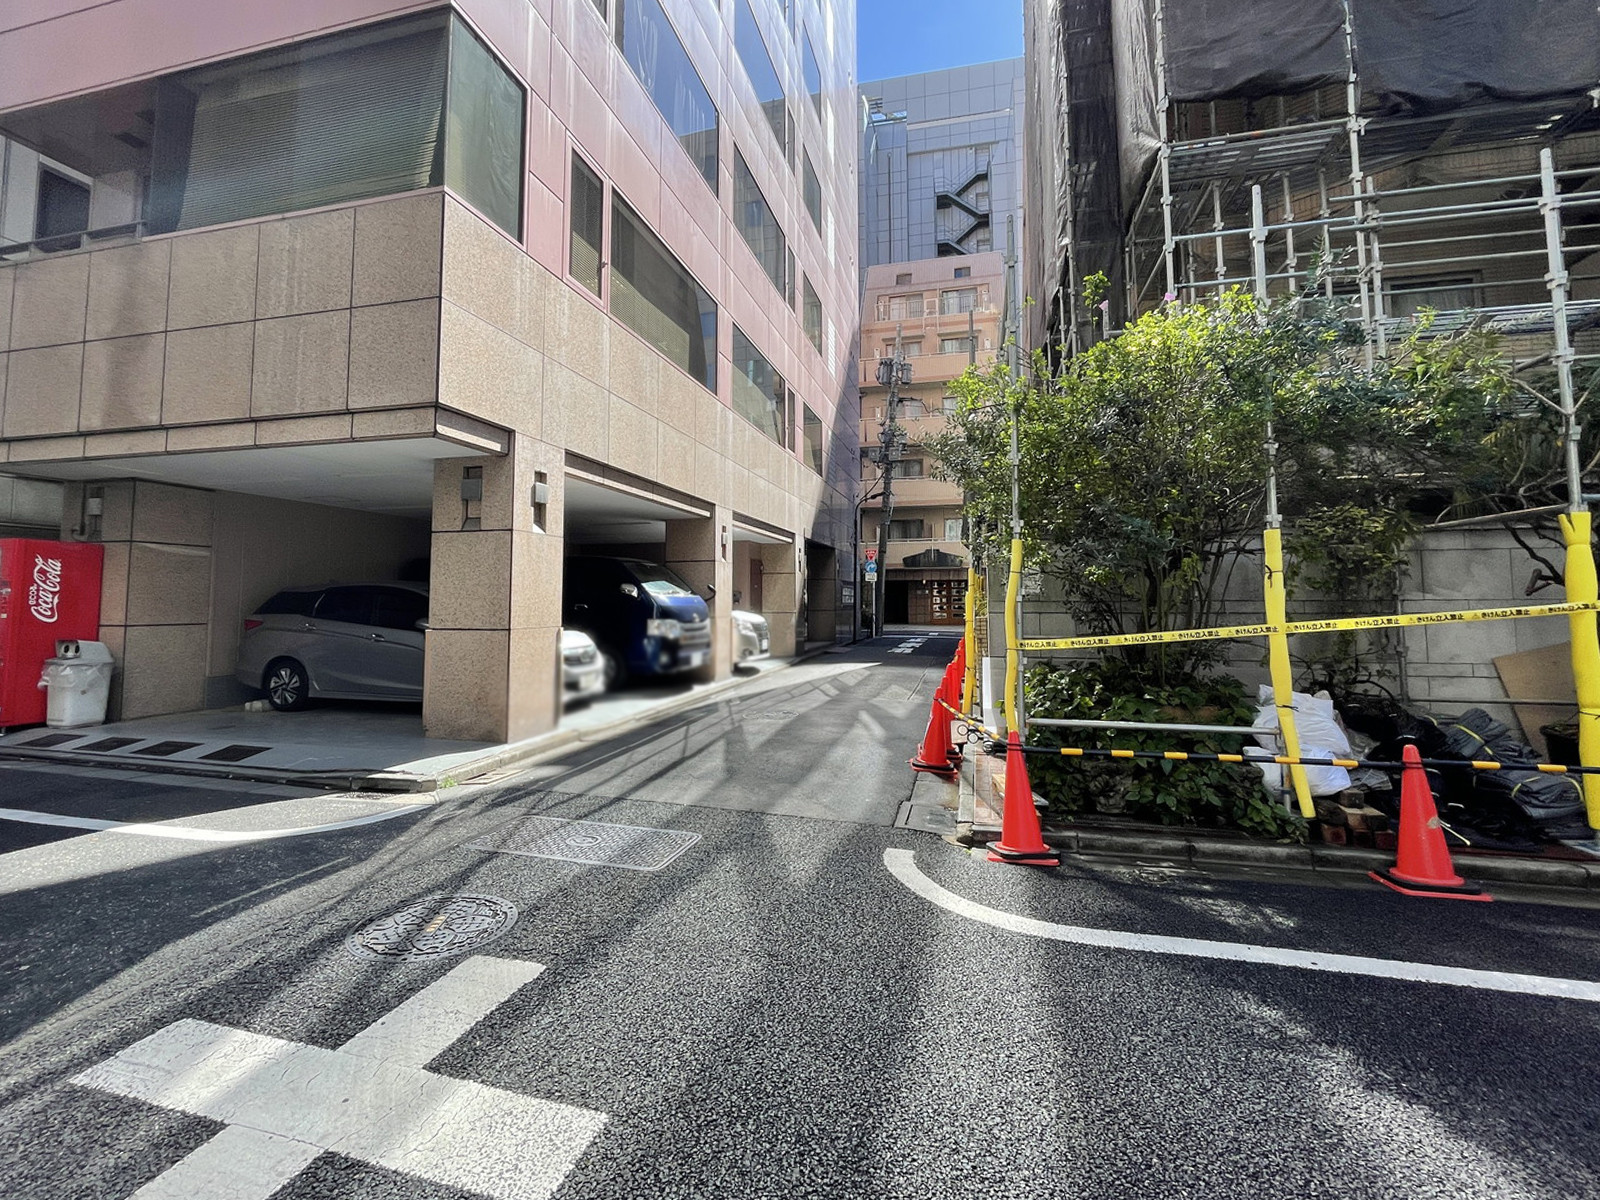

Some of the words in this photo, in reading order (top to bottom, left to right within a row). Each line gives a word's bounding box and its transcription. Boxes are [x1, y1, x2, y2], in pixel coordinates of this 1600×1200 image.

[30, 553, 62, 623] Coca-Cola
[1235, 626, 1279, 635] きけん立入禁止
[1293, 622, 1338, 631] きけん立入禁止
[1481, 609, 1530, 618] きけん立入禁止
